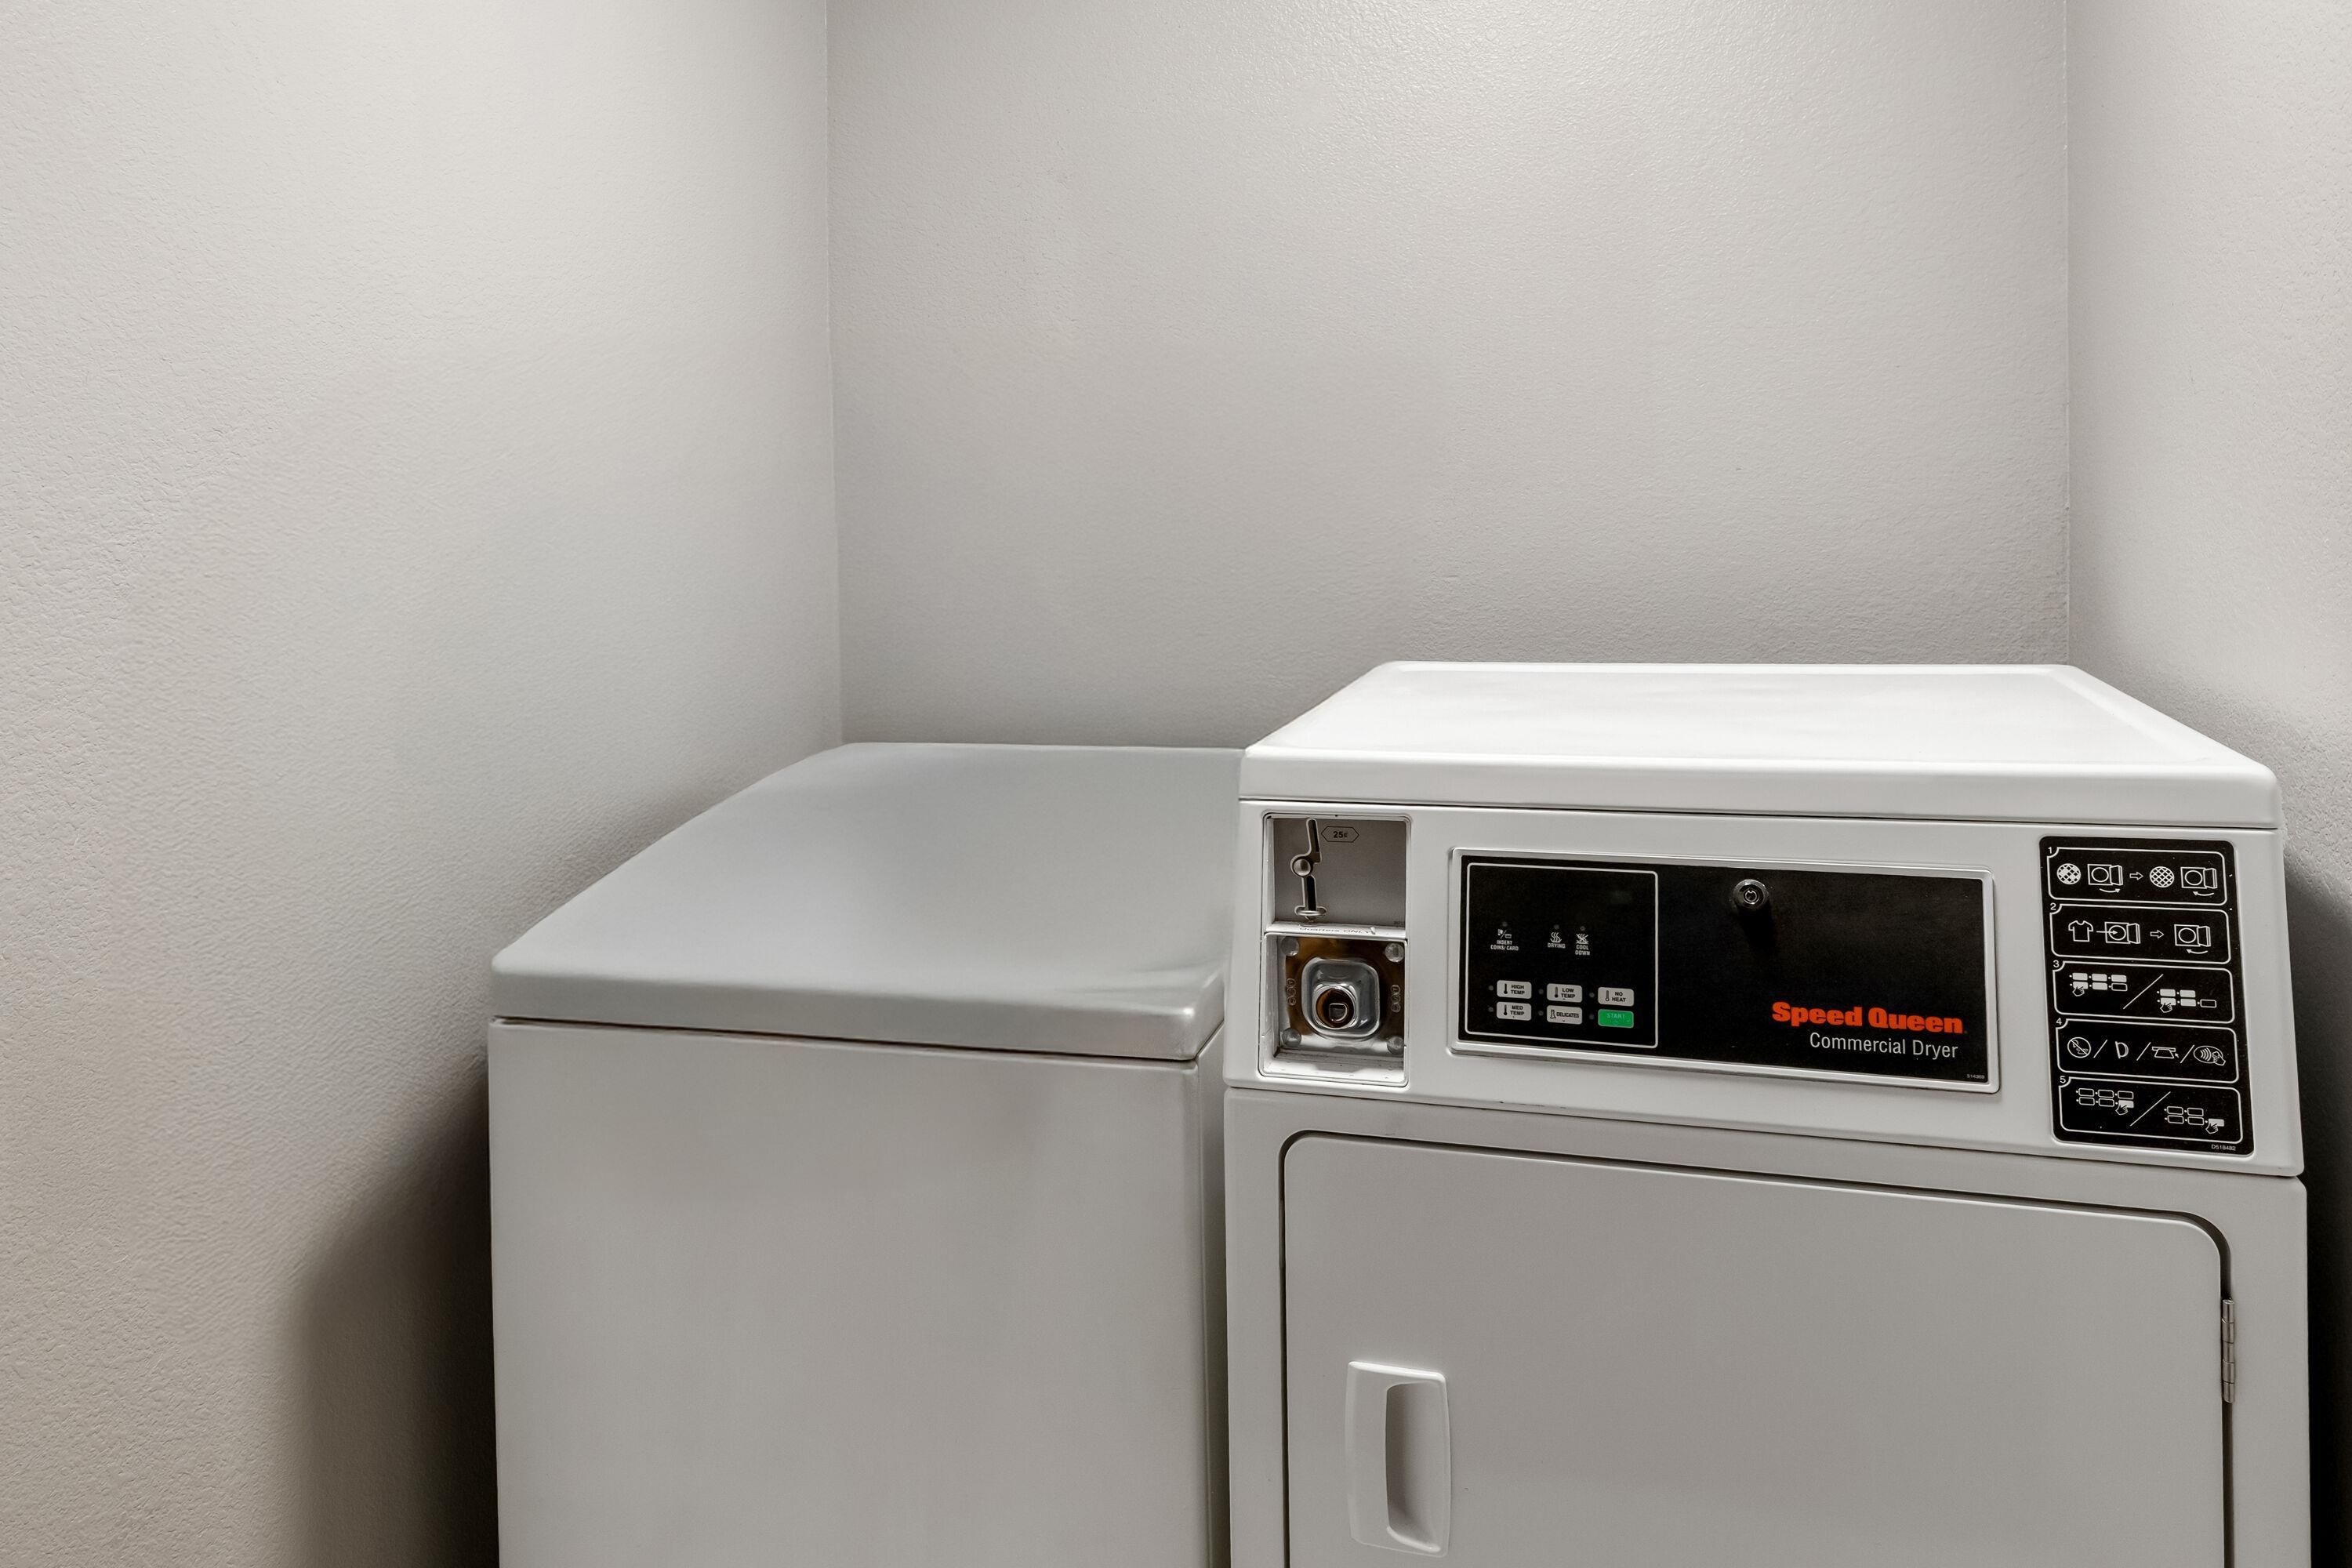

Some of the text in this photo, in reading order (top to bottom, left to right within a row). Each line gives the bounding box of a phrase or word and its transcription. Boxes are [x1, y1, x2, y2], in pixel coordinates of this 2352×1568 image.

[1772, 1001, 1963, 1034] Speed Queen
[1809, 1032, 1958, 1060] Commercial Dryer
